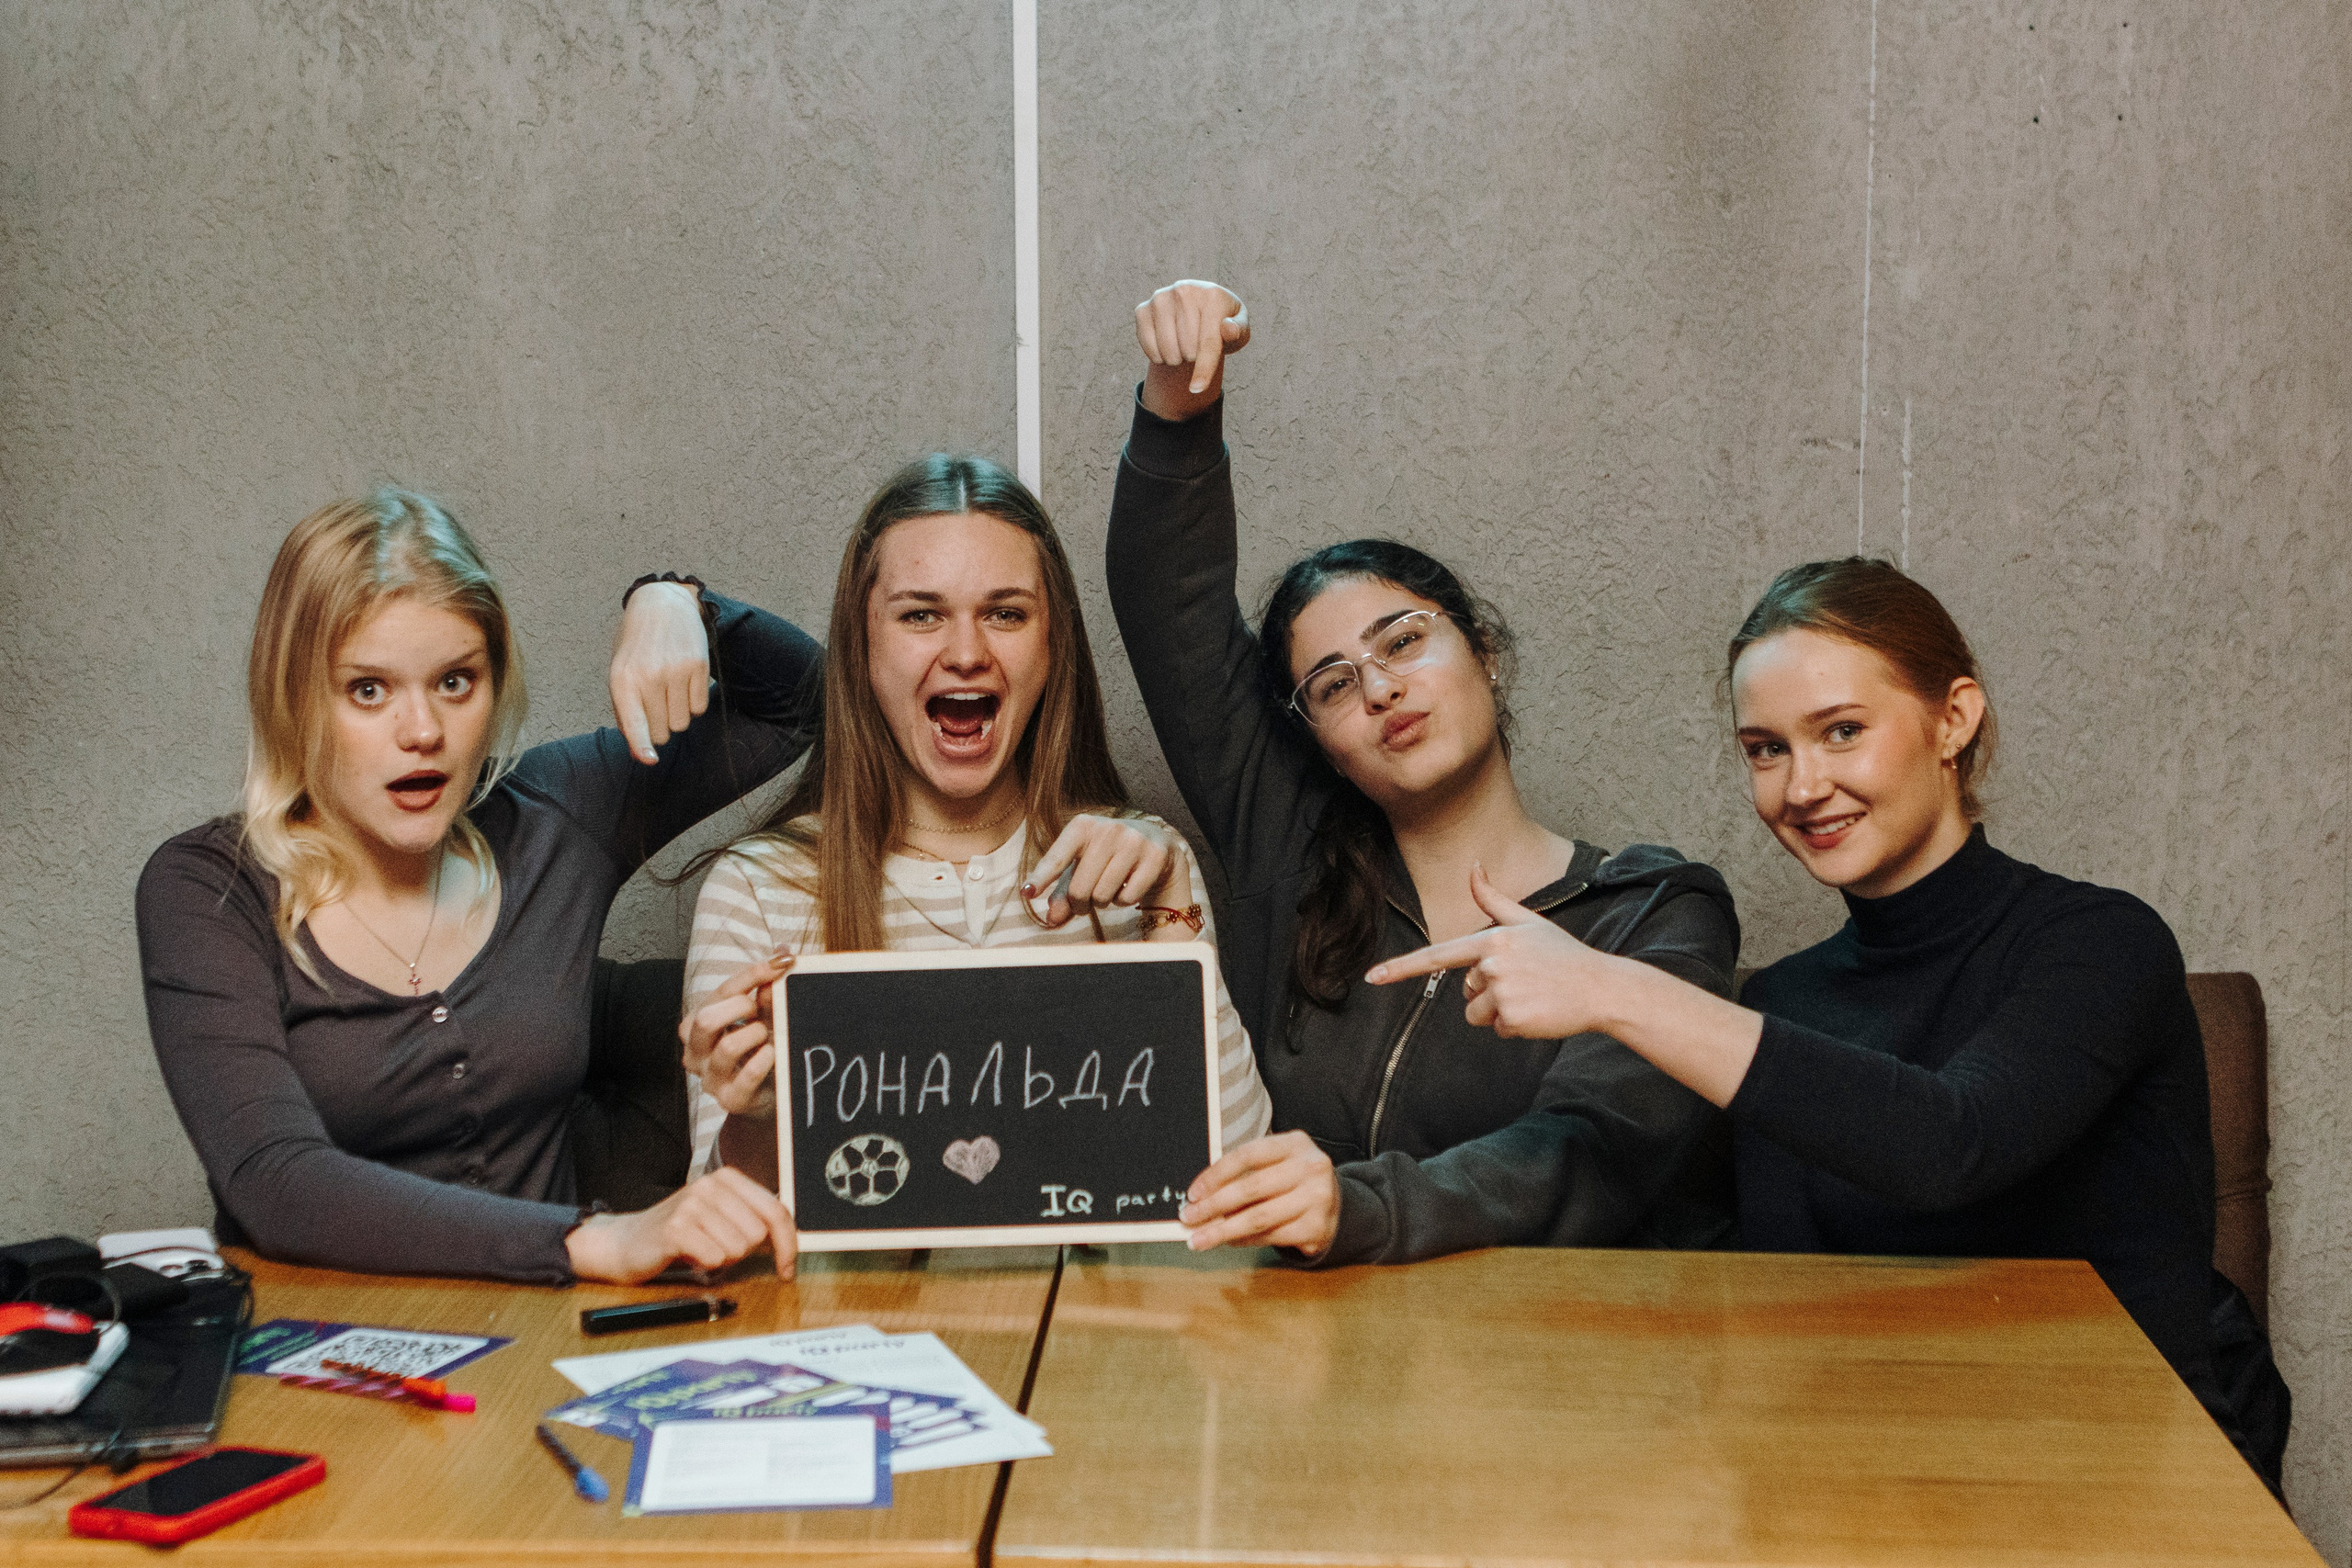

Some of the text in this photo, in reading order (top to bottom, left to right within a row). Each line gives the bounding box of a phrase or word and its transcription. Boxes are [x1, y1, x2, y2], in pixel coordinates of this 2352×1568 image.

[803, 1041, 1155, 1129] РОНАЛЬДА
[1039, 1184, 1188, 1218] IQ party
